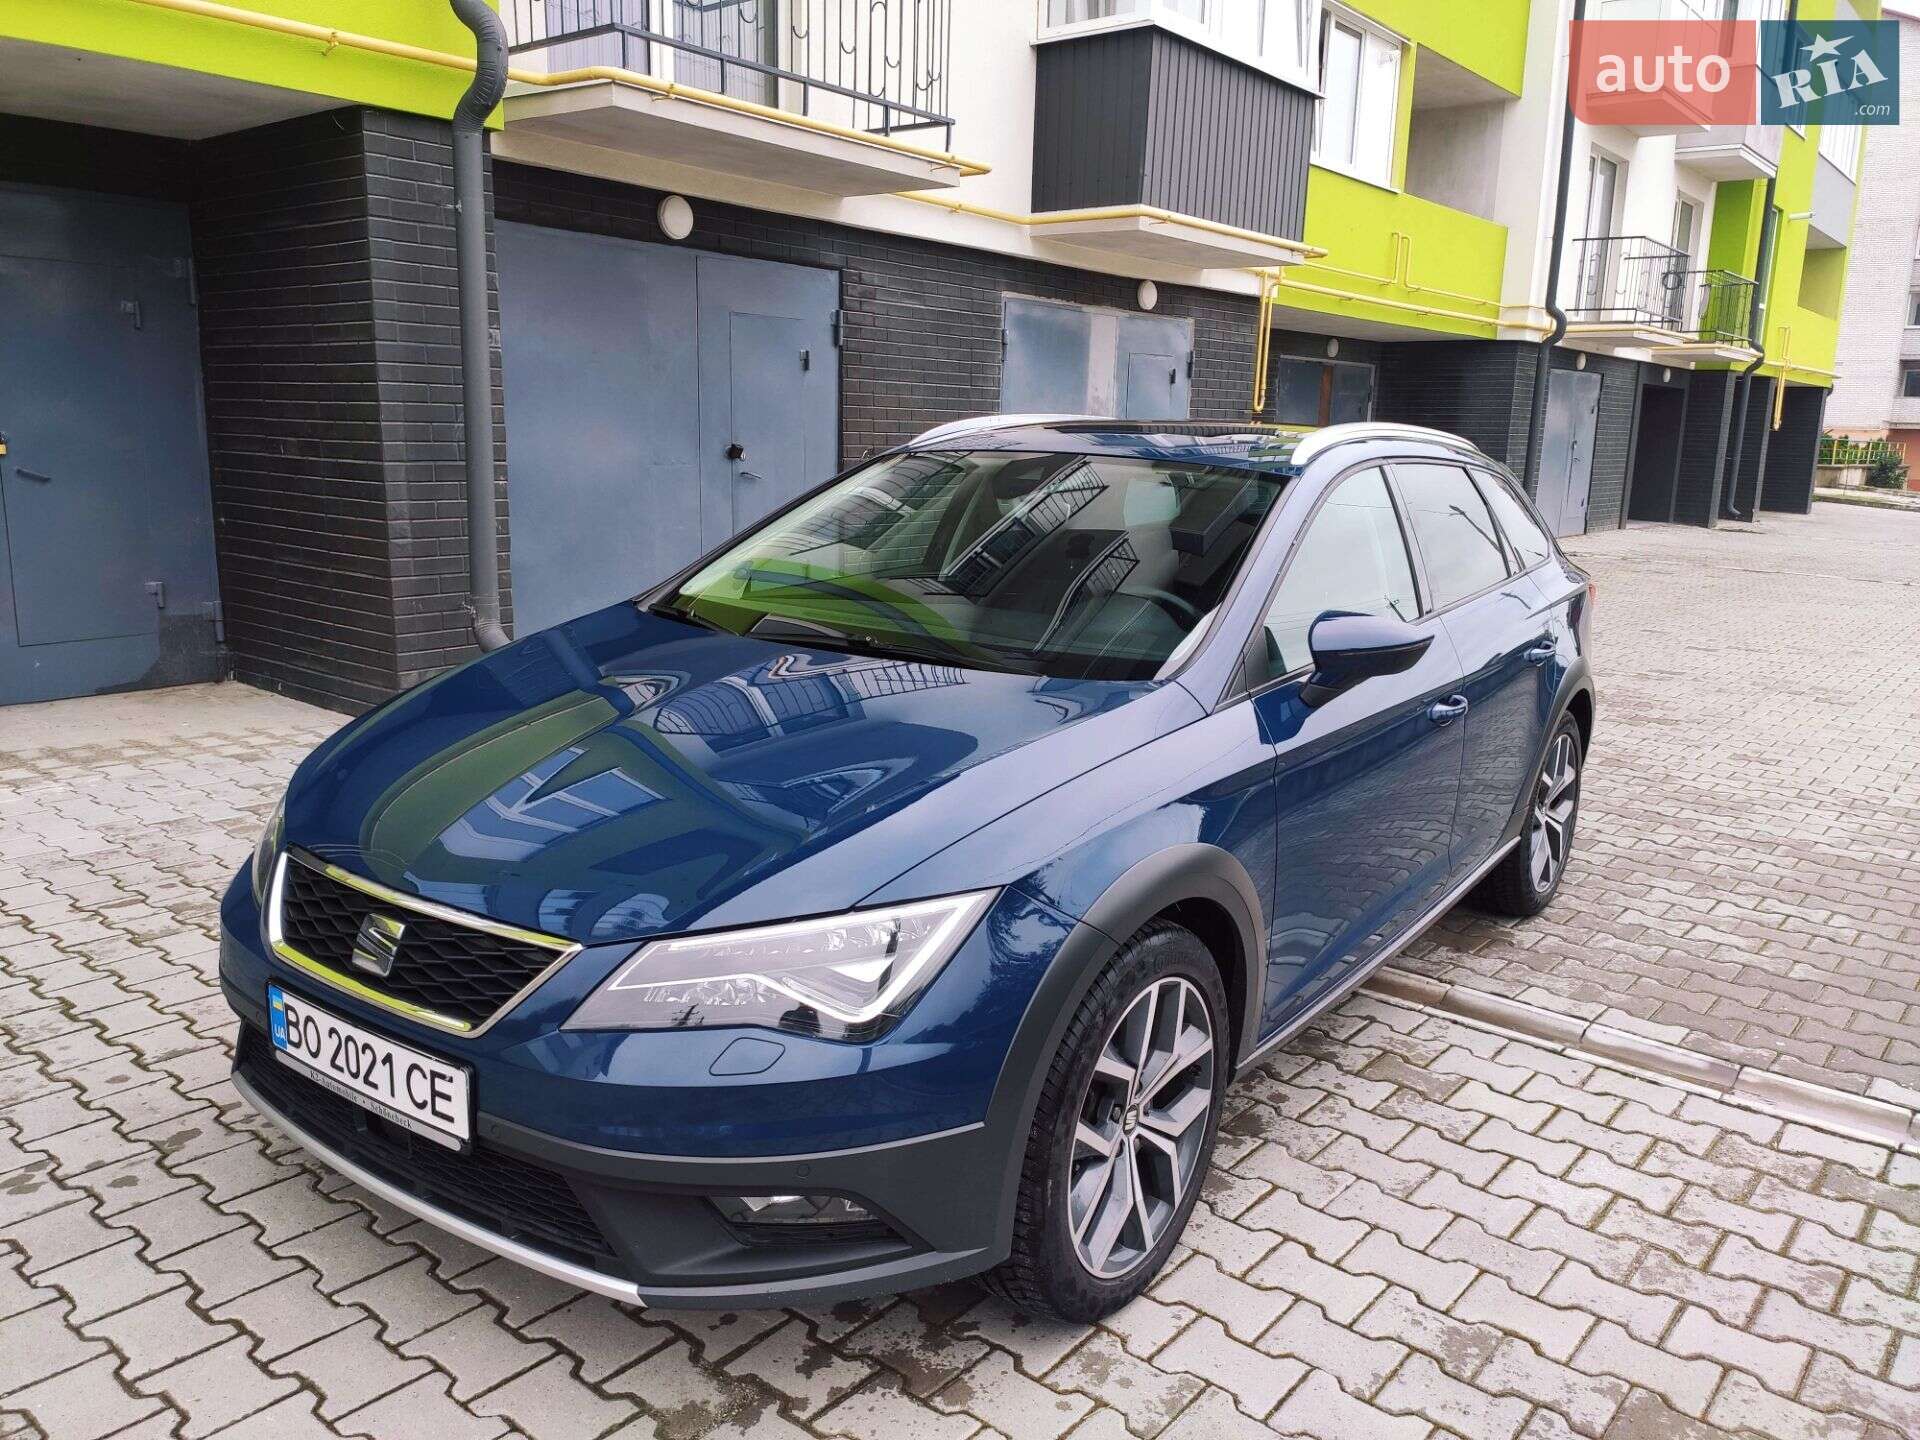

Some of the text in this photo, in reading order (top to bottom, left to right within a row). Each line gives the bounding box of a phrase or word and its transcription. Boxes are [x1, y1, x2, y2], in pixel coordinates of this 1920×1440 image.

[274, 1024, 286, 1040] UA
[284, 1002, 455, 1124] BO 2021 CE
